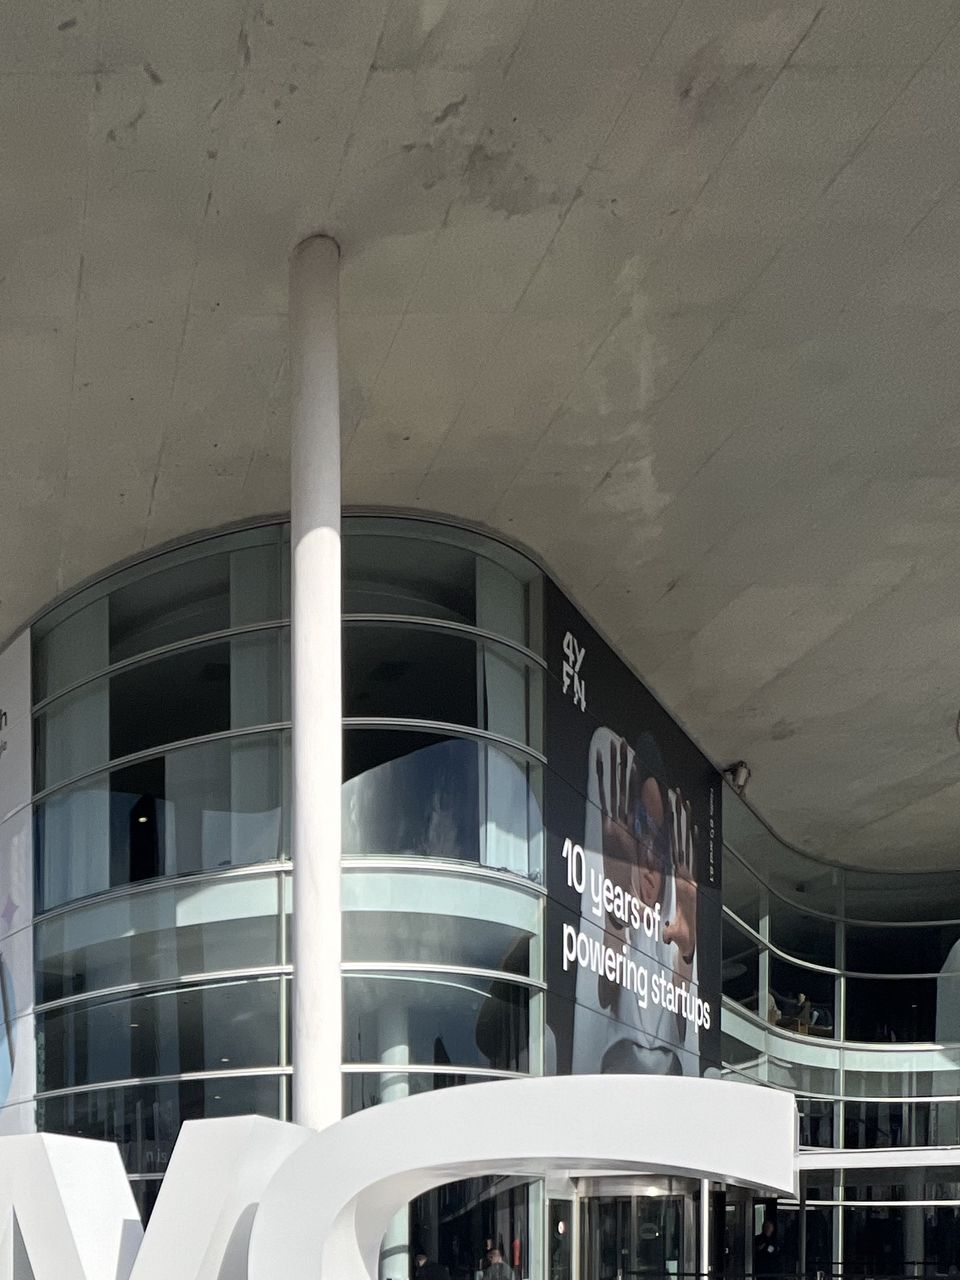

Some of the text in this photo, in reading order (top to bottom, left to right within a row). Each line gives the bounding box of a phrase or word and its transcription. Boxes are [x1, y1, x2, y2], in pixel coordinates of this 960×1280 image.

[562, 837, 661, 942] 10 years of
[562, 922, 711, 1034] powering startups
